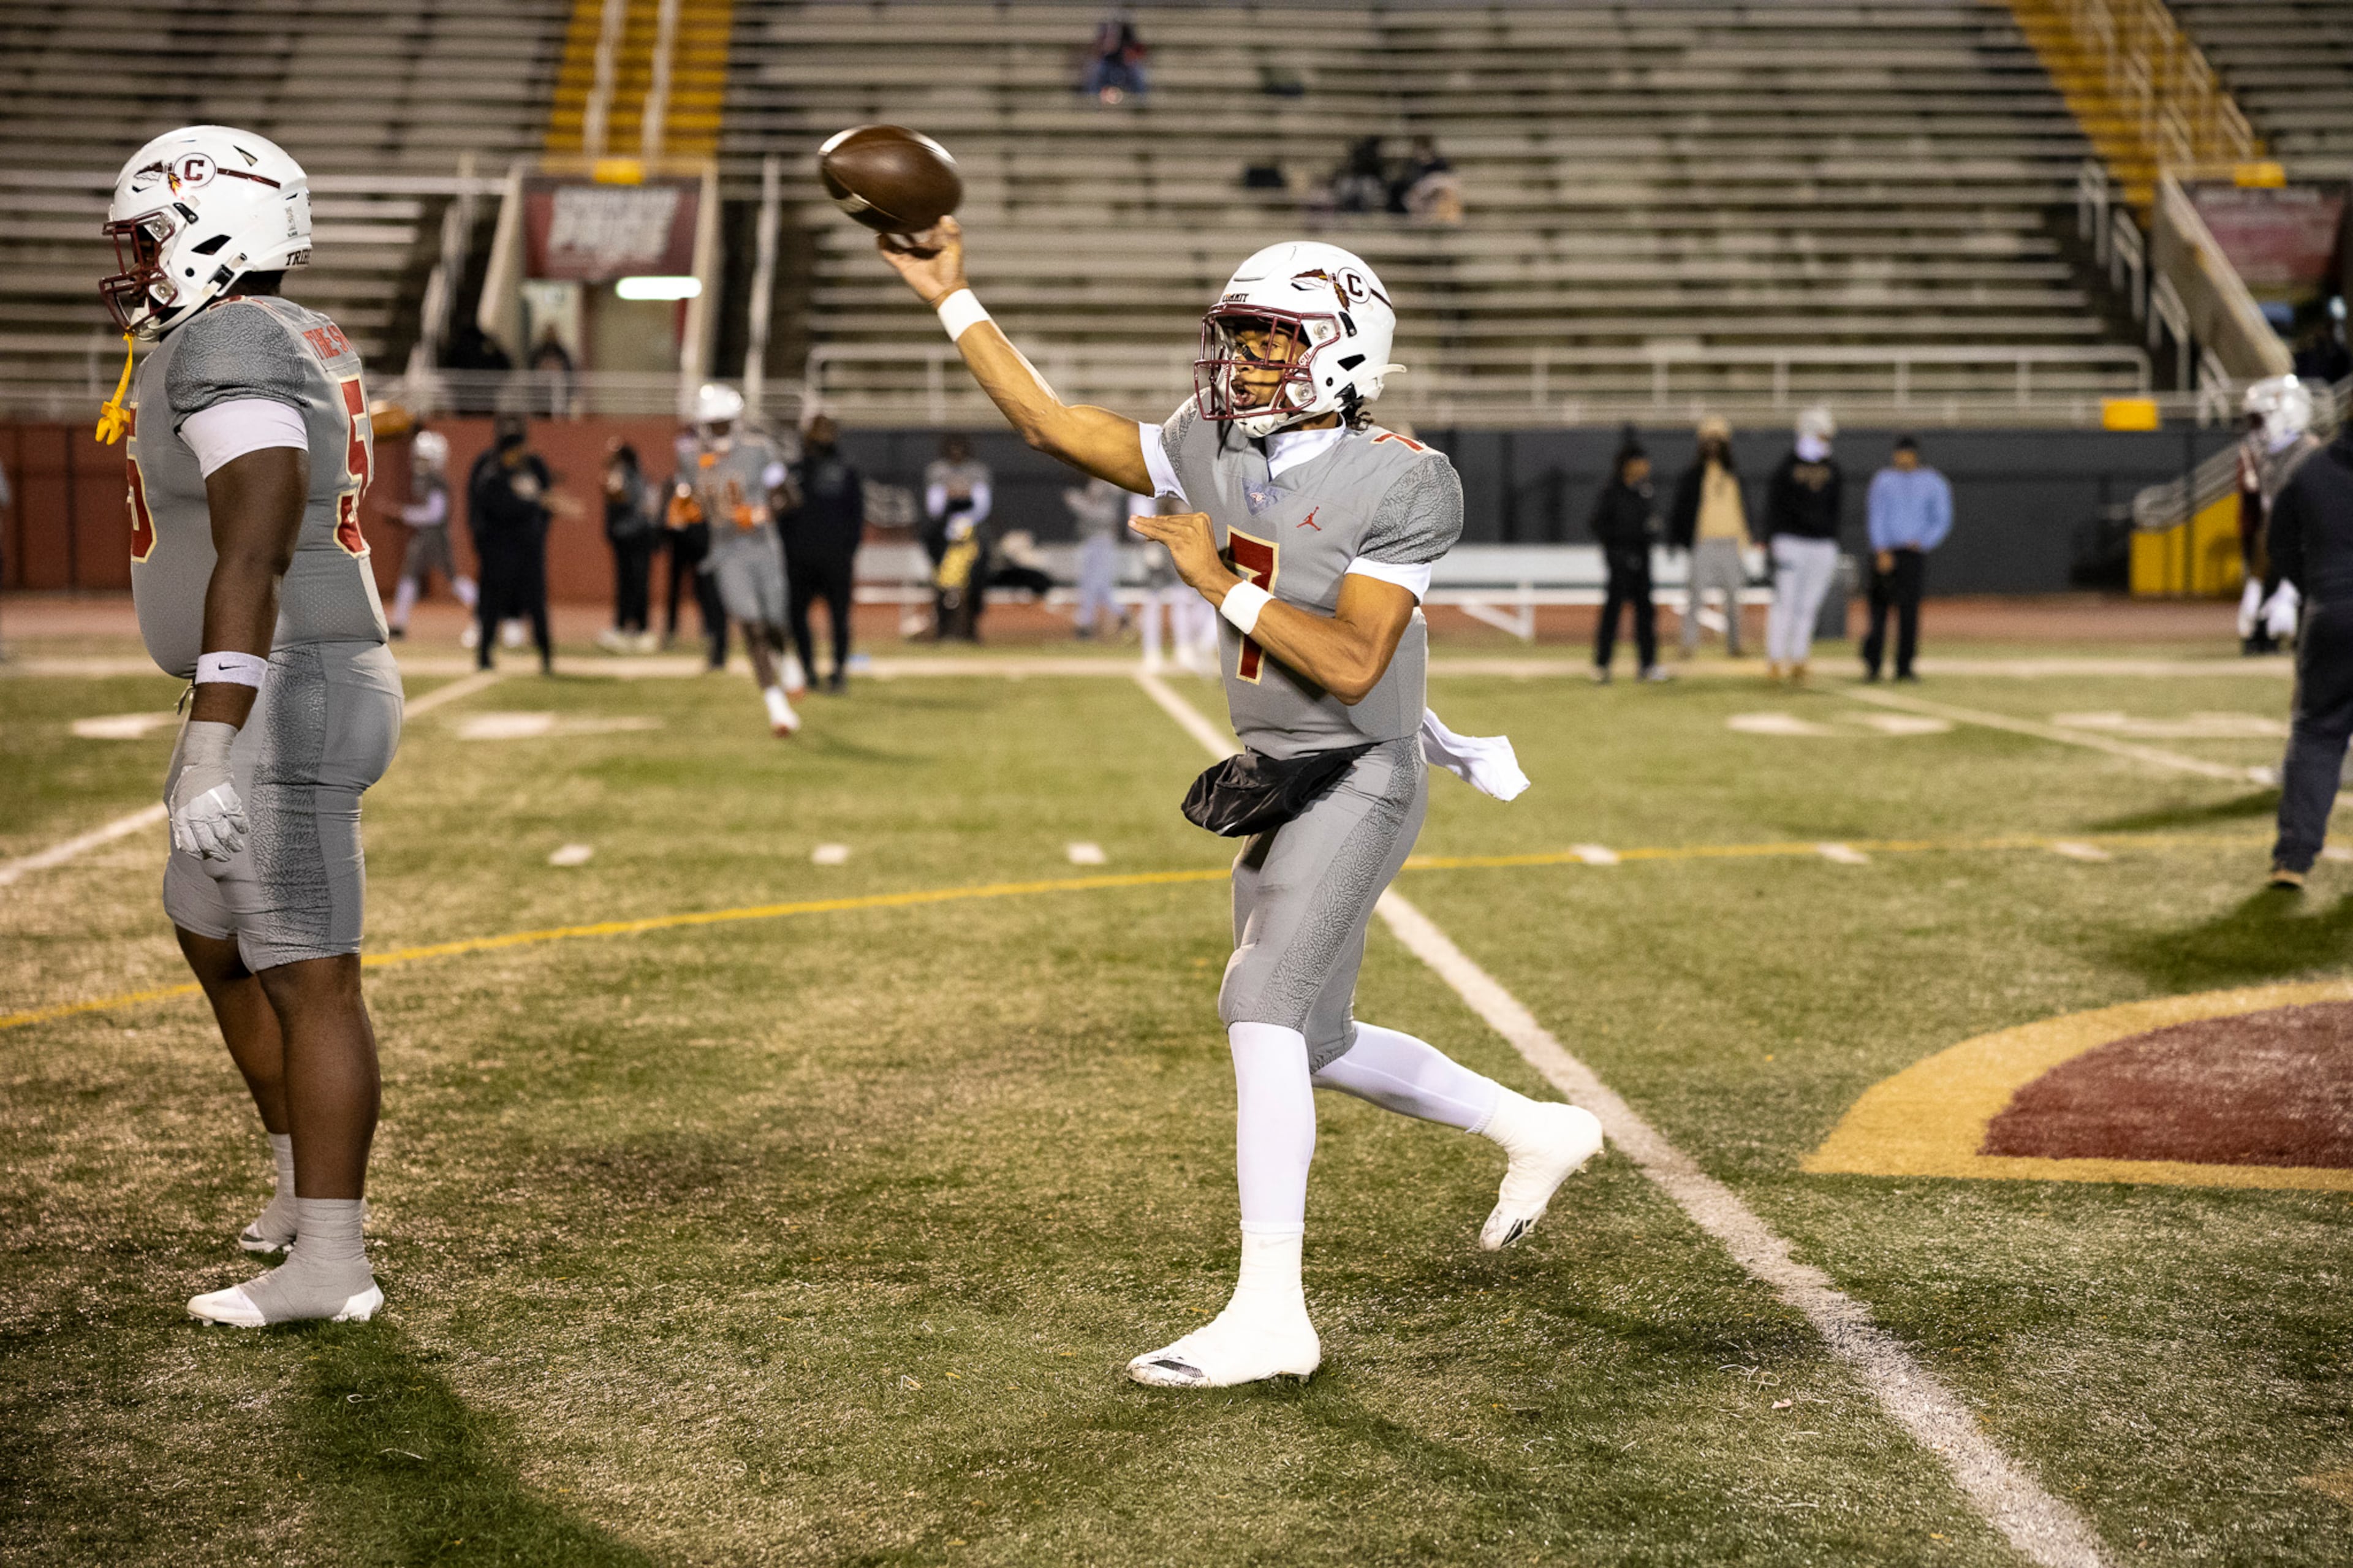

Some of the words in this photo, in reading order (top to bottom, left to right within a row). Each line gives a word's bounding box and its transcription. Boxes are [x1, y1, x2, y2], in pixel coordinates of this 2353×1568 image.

[184, 159, 205, 181] C
[1346, 273, 1363, 297] C
[301, 327, 341, 360] THE
[1227, 525, 1279, 686] 7
